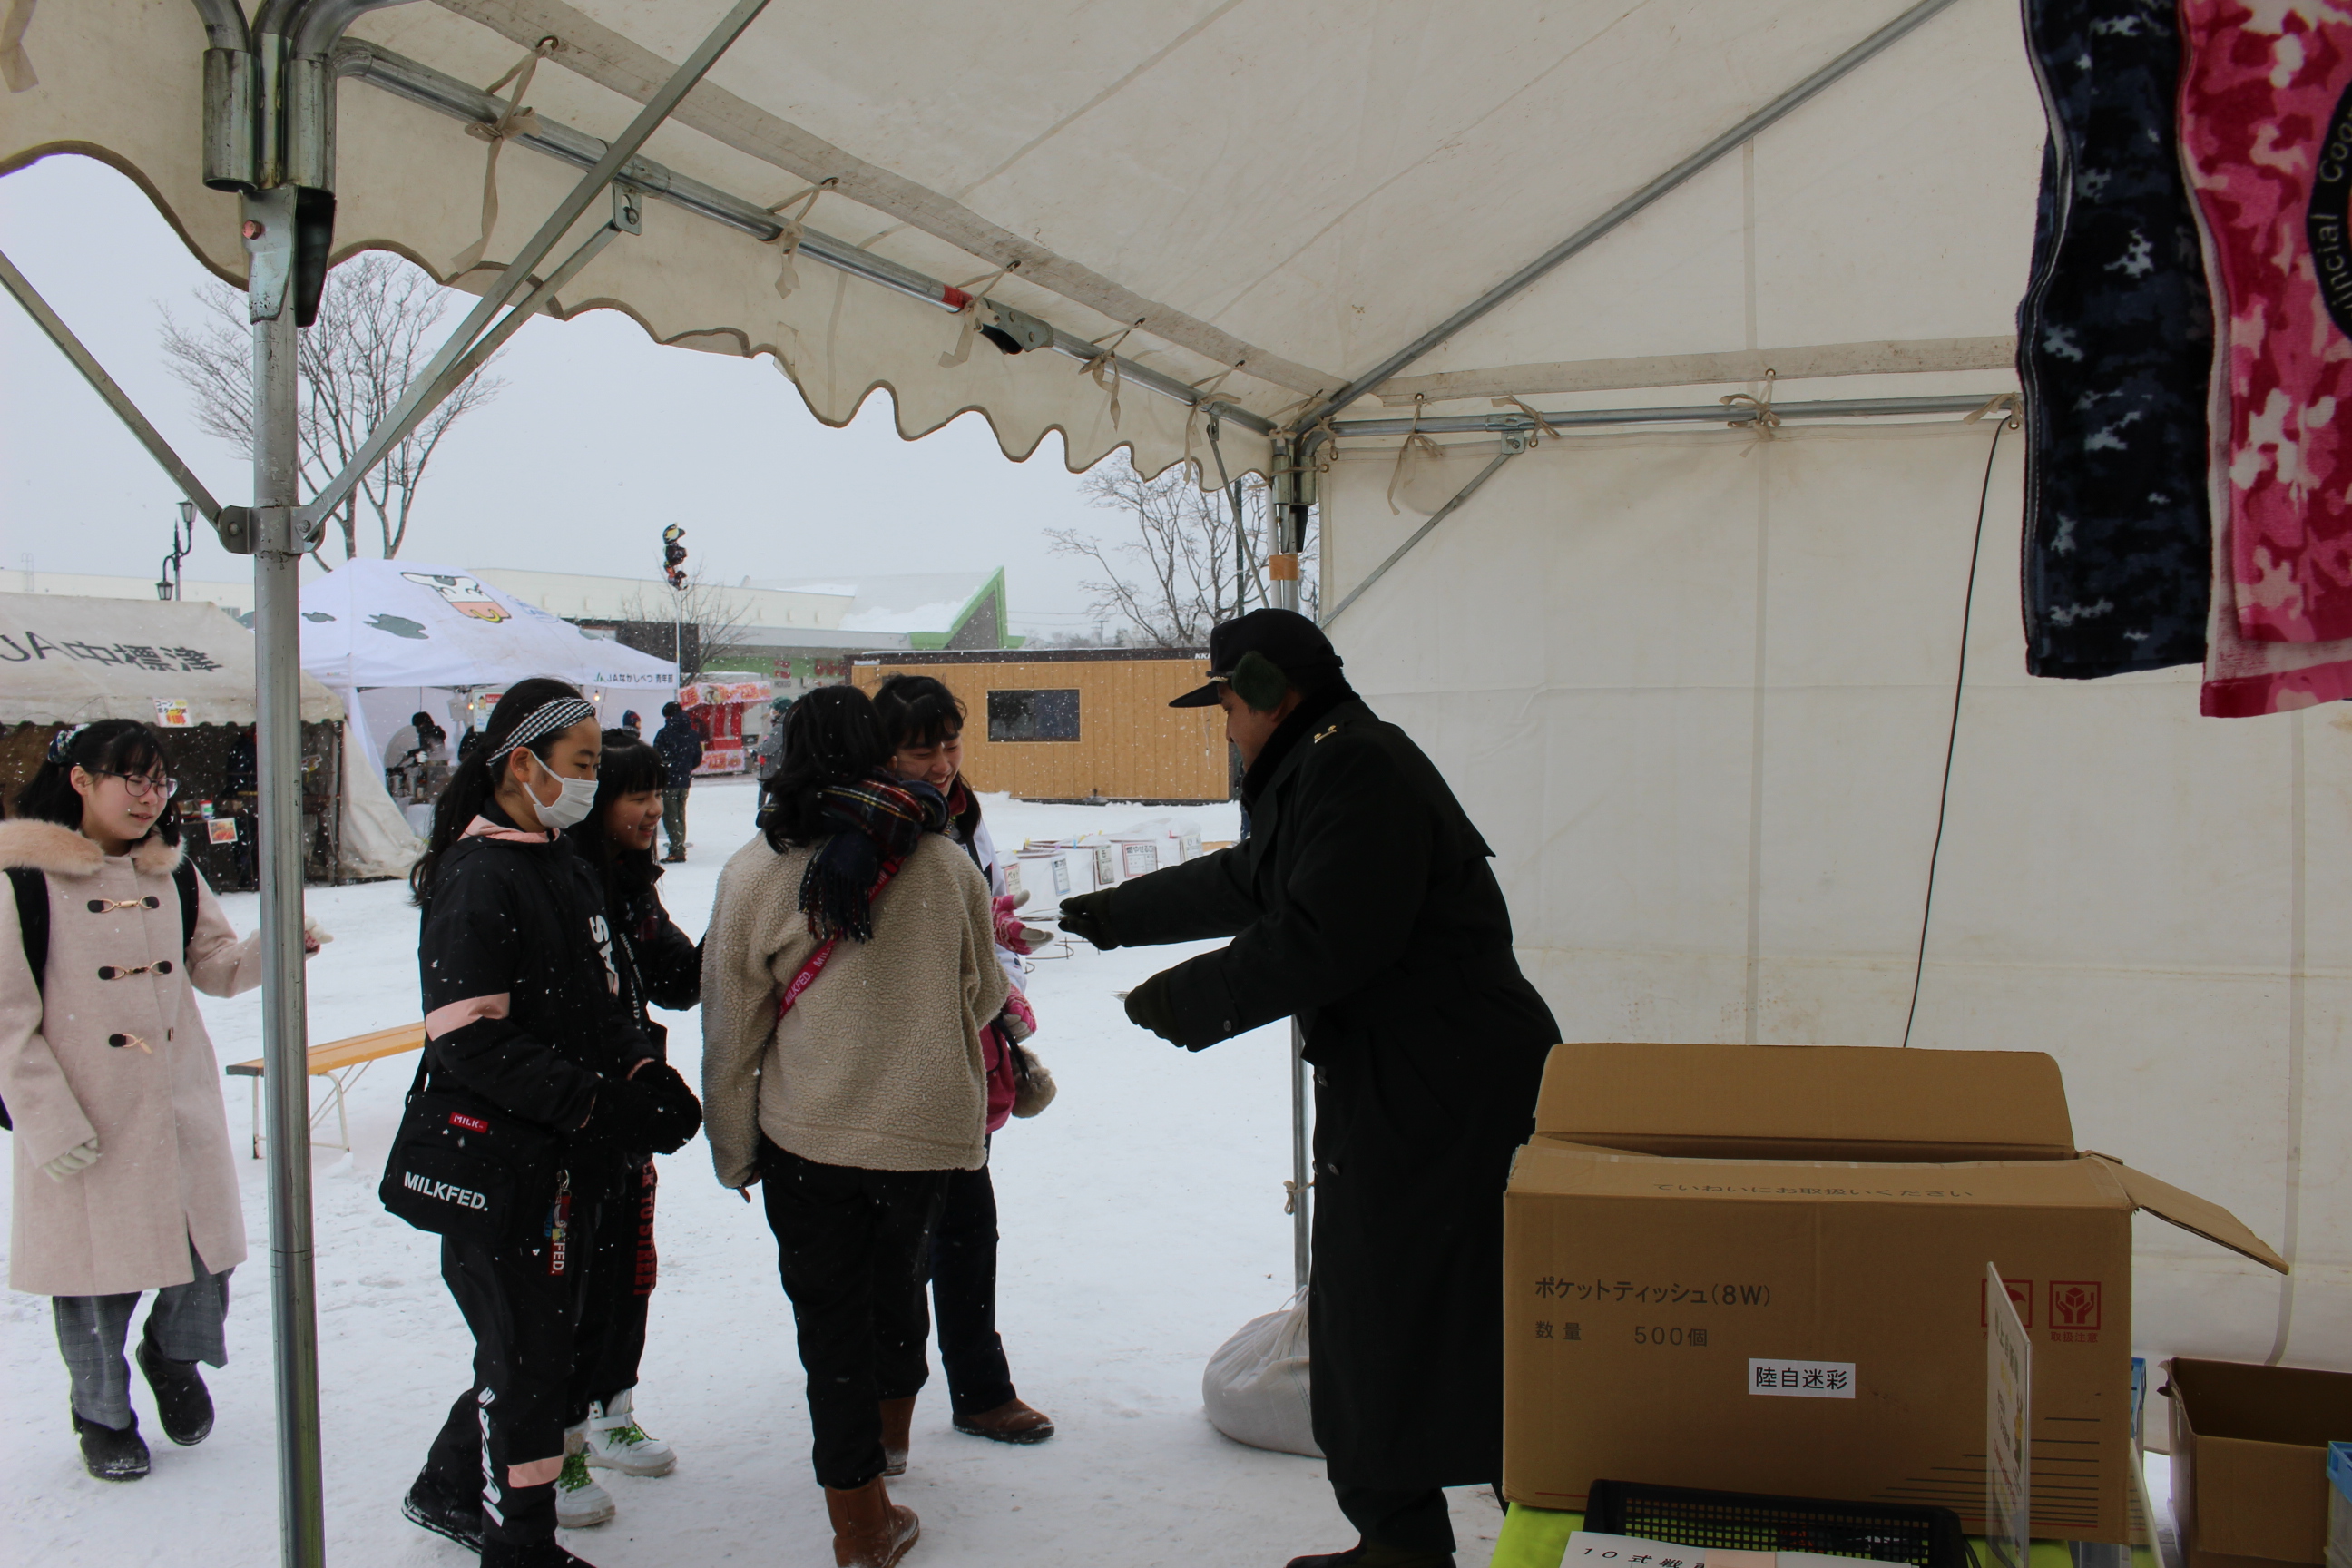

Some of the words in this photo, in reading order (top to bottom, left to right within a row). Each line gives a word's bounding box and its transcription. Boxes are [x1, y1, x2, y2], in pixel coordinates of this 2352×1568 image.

[2318, 111, 2352, 183] Coo
[0, 631, 224, 672] JA中標津
[641, 1161, 655, 1189] CK
[404, 1171, 489, 1212] MILKFED.
[1652, 1182, 1974, 1199] ていねいにお取扱いください
[552, 1239, 565, 1274] FED.
[1534, 1276, 1771, 1309] ポケットティッシュ(8W)
[1634, 1324, 1709, 1348] 500個
[2050, 1330, 2099, 1344] 取扱注意
[1755, 1365, 1848, 1392] 陸自迷彩
